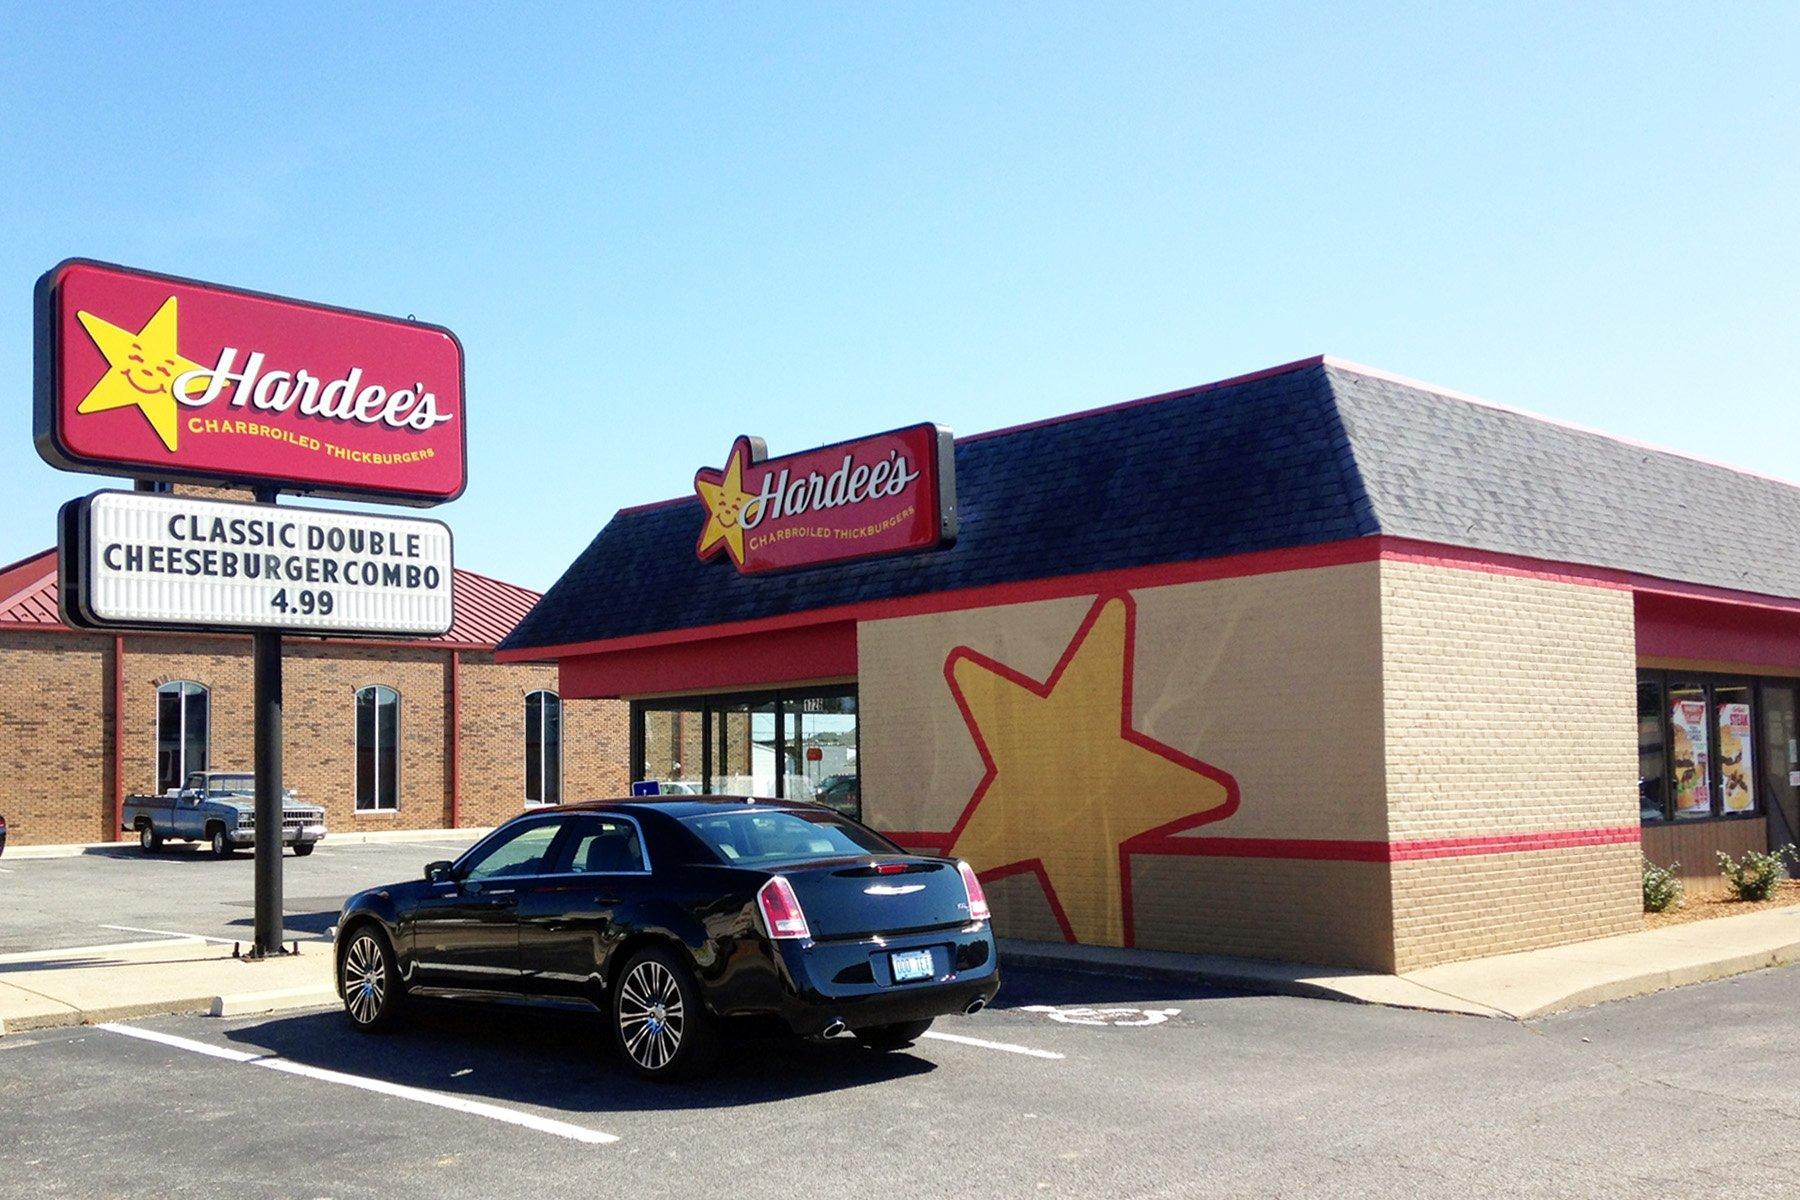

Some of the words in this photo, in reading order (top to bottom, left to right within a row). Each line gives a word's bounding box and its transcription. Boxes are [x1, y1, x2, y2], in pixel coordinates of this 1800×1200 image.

[172, 347, 453, 431] Hardee's
[188, 418, 321, 451] CHARBROILED
[326, 444, 435, 465] THICKBURGERS
[738, 450, 920, 529] Hardee's
[168, 514, 296, 549] CLASSIC
[307, 525, 420, 558] DOUBLE
[750, 526, 831, 550] CHARBROILED
[834, 506, 915, 539] THICKBURGERS
[270, 587, 334, 616] 4.99
